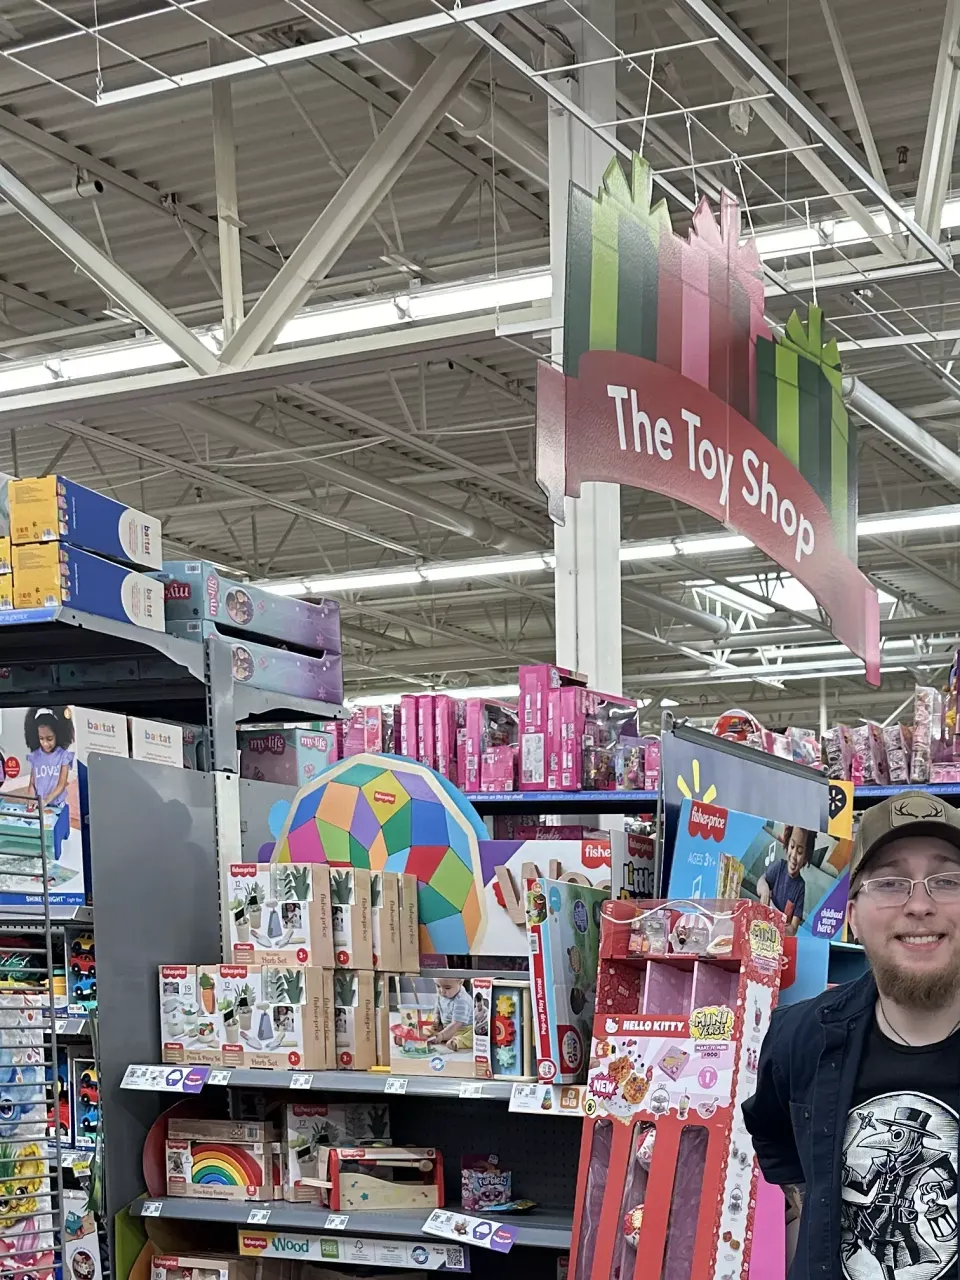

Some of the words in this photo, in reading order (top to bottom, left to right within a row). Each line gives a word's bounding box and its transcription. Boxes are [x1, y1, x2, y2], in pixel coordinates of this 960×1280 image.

[606, 384, 673, 461] The
[681, 408, 735, 506] Toy
[741, 449, 815, 562] Shop
[87, 719, 115, 733] battat
[144, 729, 172, 744] battat
[691, 806, 726, 830] fisher-price
[687, 852, 703, 864] AGES
[821, 905, 844, 921] childhood
[822, 916, 836, 927] starts
[221, 967, 246, 976] fisher-price
[537, 999, 545, 1013] Play
[694, 1010, 729, 1026] MINI
[623, 1020, 651, 1031] HELLO
[653, 1021, 684, 1031] KITTY
[698, 1024, 725, 1036] VERSE
[267, 1059, 278, 1067] Set
[594, 1080, 614, 1093] NEW
[272, 1237, 309, 1253] Wood
